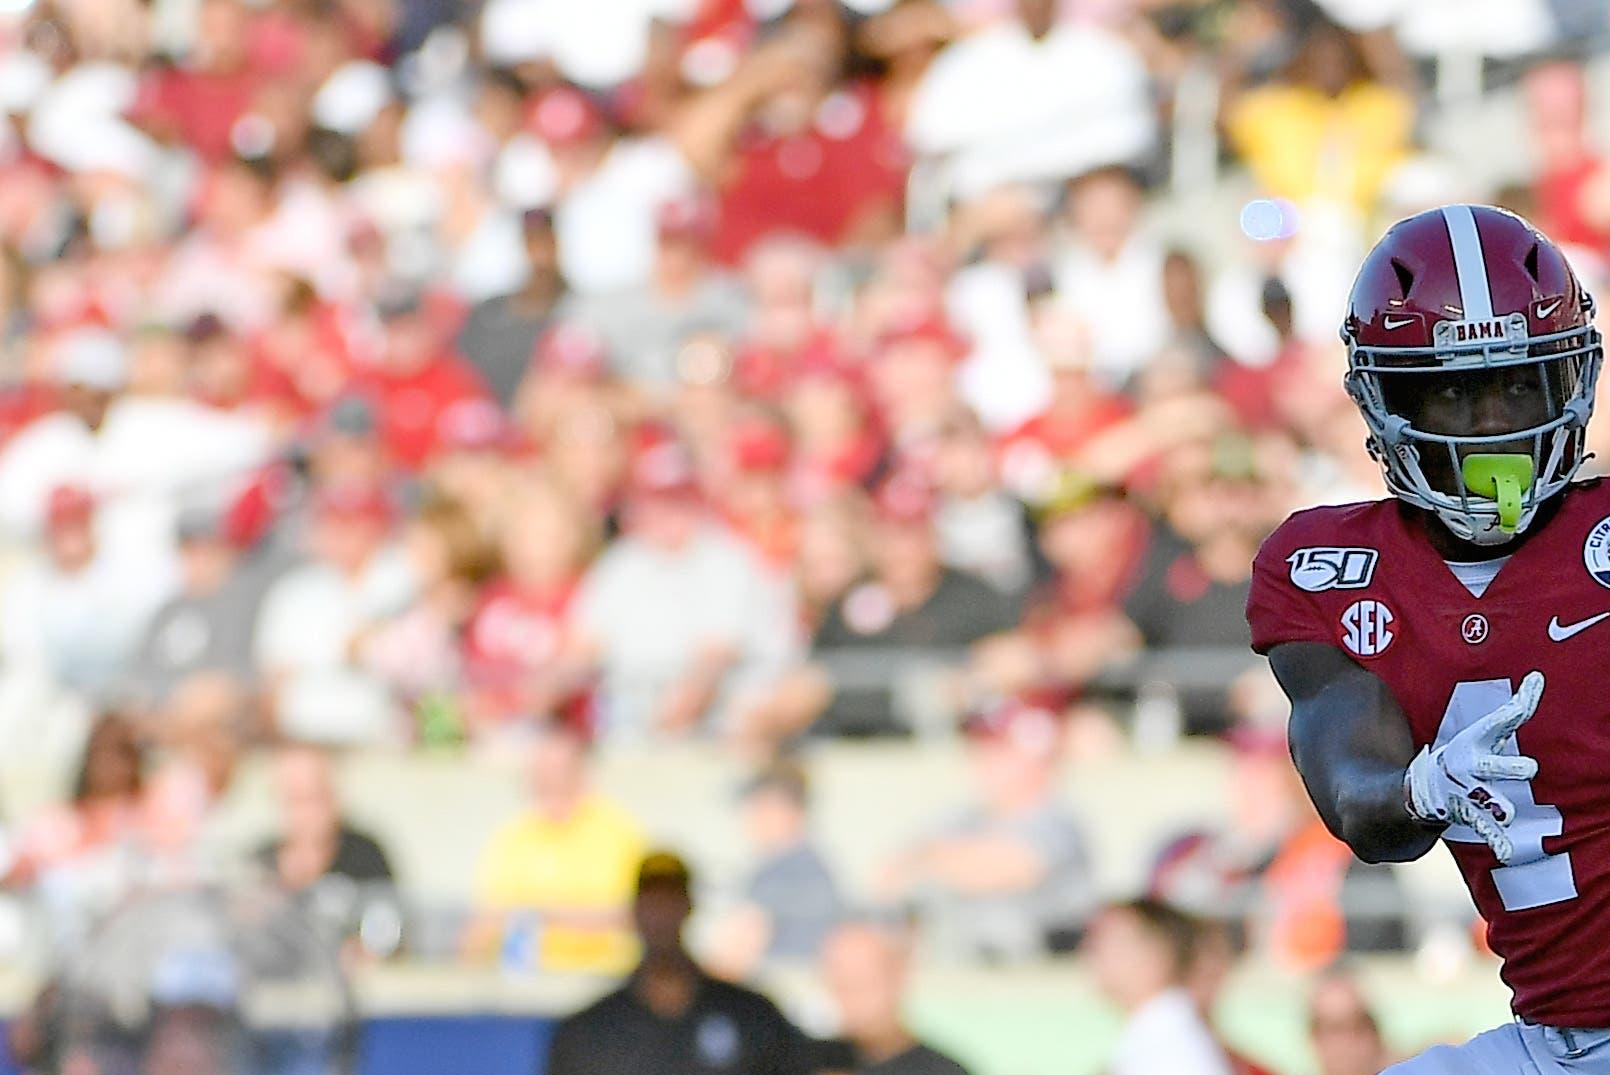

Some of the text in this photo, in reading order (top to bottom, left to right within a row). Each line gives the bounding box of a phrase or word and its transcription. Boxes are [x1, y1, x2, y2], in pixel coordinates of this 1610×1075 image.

[1456, 321, 1504, 342] BAMA
[1287, 547, 1379, 591] 150
[1340, 600, 1395, 656] SEC
[1431, 678, 1579, 912] 4
